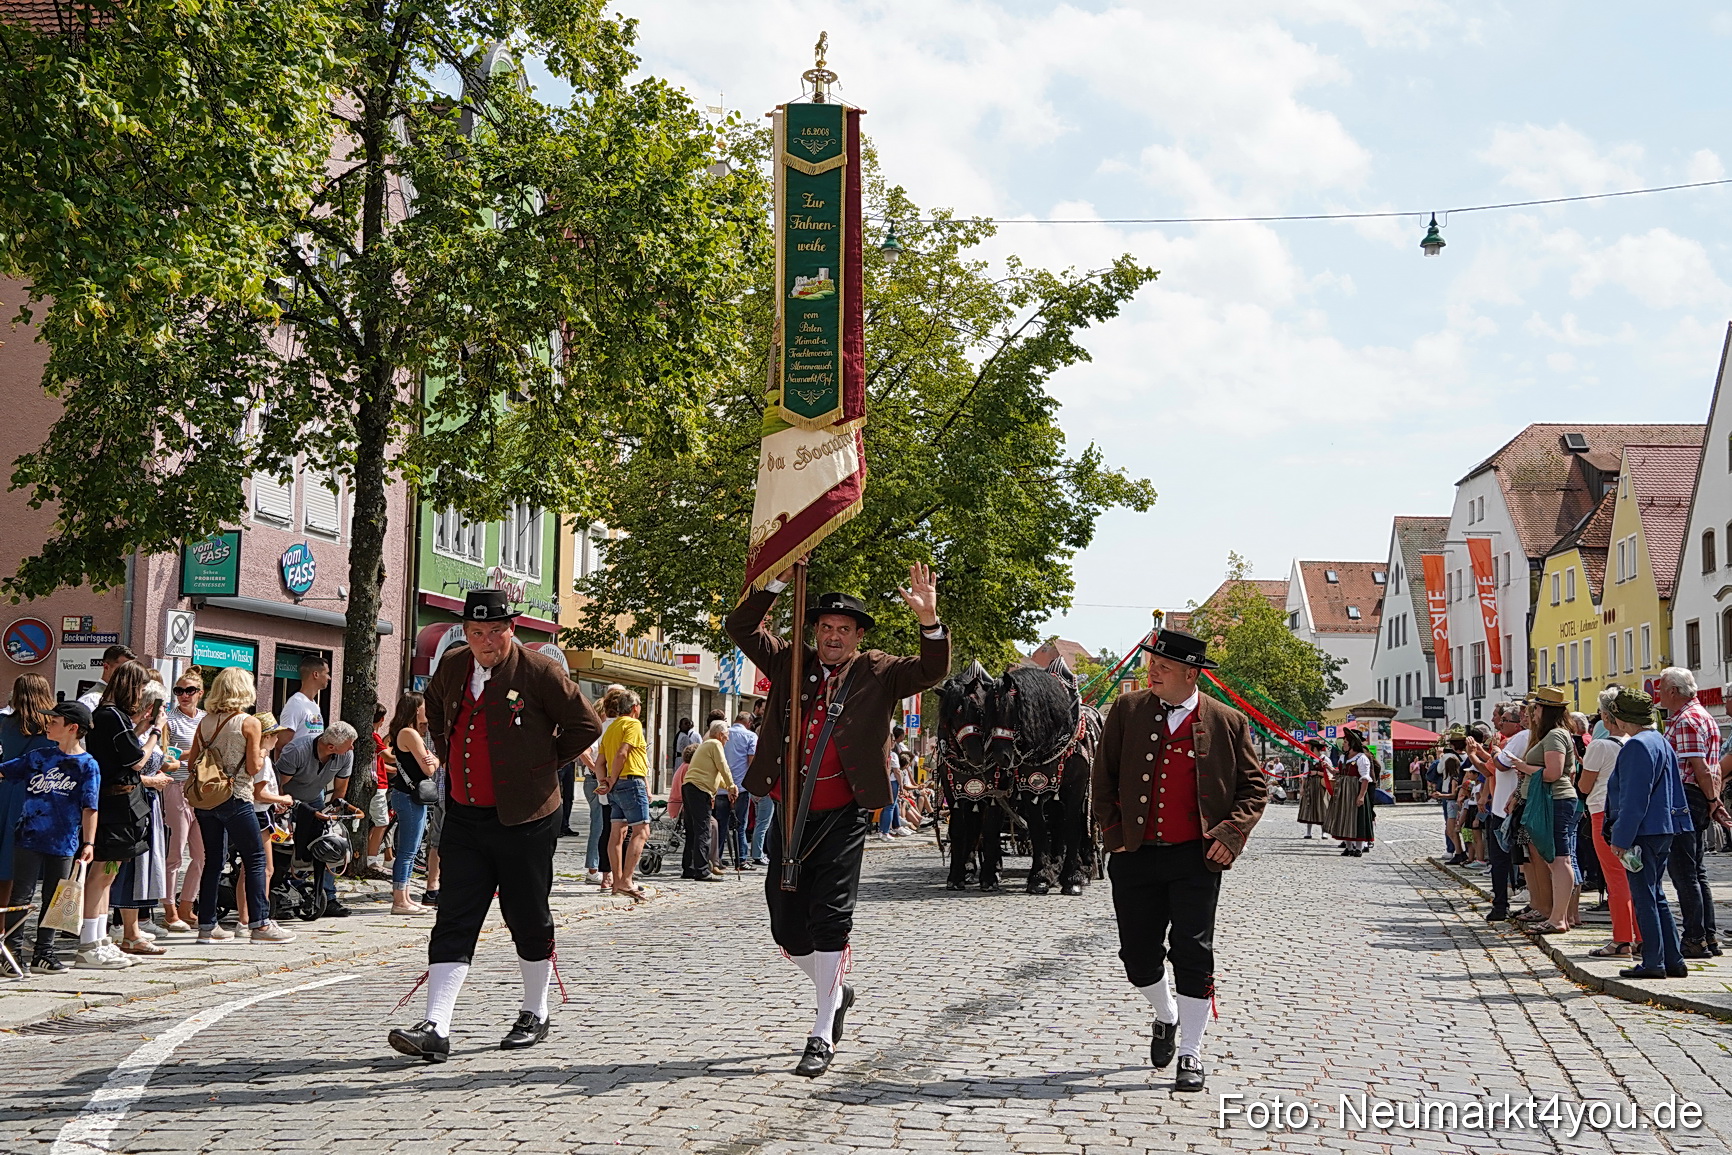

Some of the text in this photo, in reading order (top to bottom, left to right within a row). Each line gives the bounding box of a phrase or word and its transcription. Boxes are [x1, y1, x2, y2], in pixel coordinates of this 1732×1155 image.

[802, 192, 825, 208] Zur
[789, 214, 837, 231] Fahnen-
[797, 237, 826, 252] weihe
[799, 321, 823, 333] Paten
[788, 347, 833, 358] Trachtenverein
[790, 360, 832, 371] Almenrausch
[192, 542, 214, 555] vom
[199, 545, 230, 564] FASS
[282, 548, 301, 568] vom
[287, 560, 316, 590] FASS
[1478, 575, 1499, 629] SALE
[1560, 621, 1577, 638] HOTEL
[64, 632, 116, 644] Bockwirtsgasse
[193, 644, 254, 667] Spirituosen Whisky
[62, 661, 87, 670] Venezia
[276, 659, 298, 672] Feinkost
[27, 773, 77, 794] Angeles
